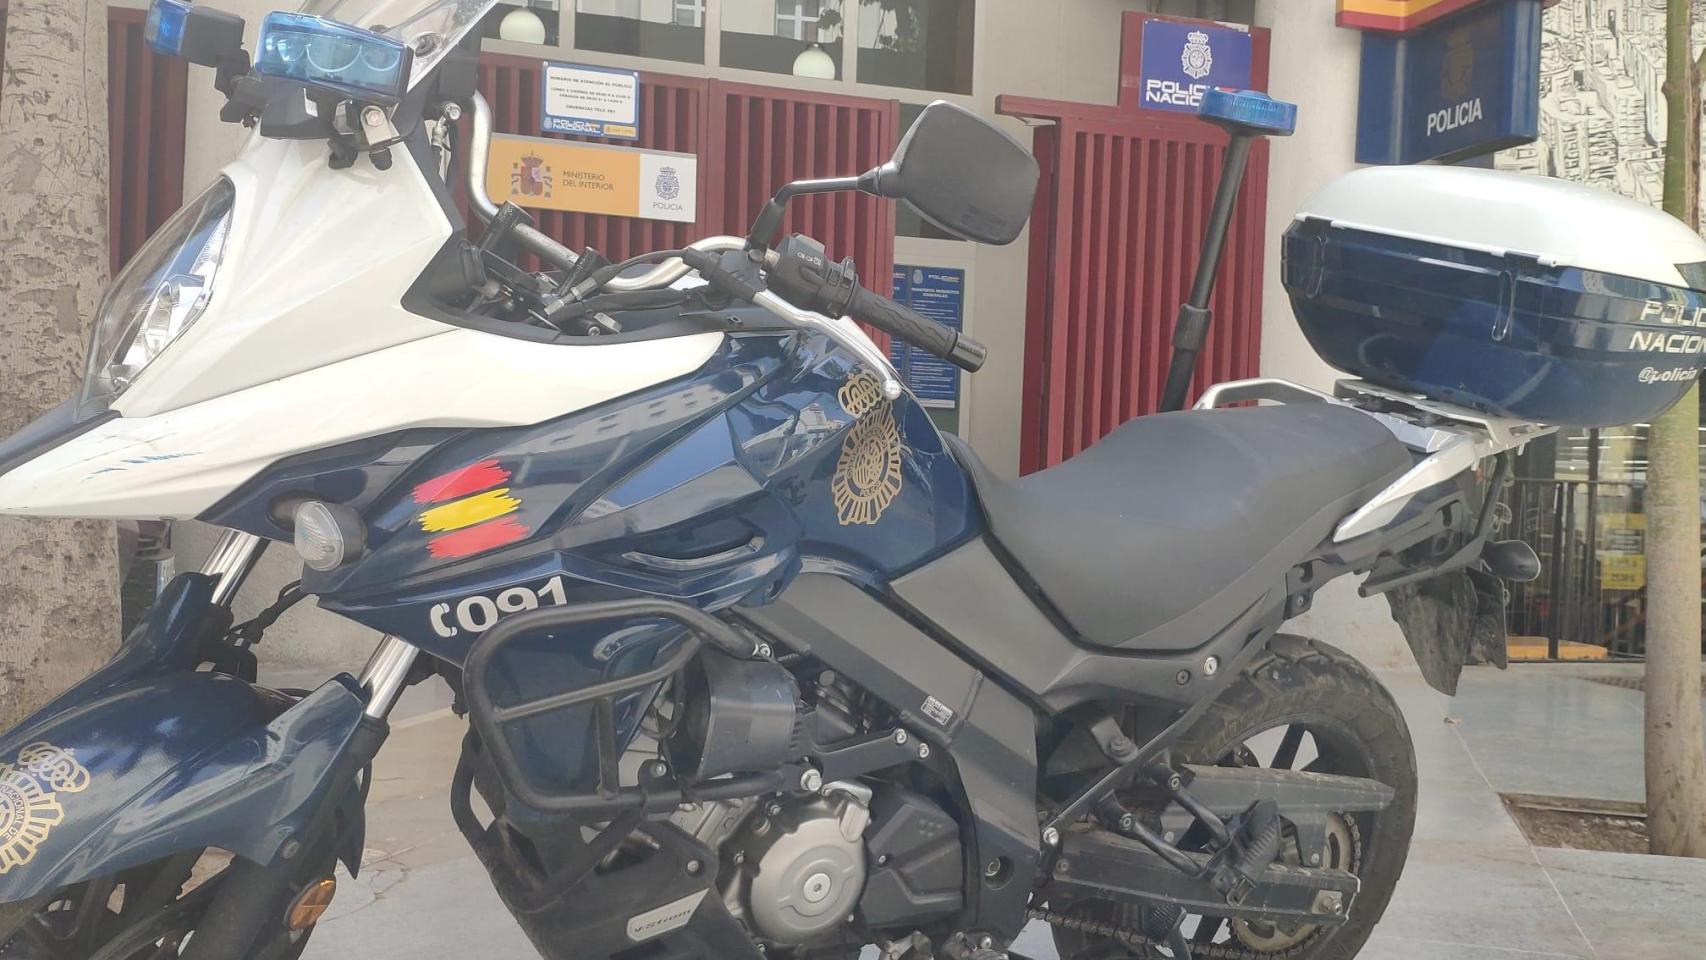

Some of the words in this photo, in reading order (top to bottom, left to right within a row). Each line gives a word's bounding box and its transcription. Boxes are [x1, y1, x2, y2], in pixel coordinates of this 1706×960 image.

[1147, 79, 1220, 96] POLIC
[1146, 91, 1201, 107] NACIO
[1427, 97, 1483, 137] POLICIA
[552, 122, 601, 134] NACIONAL
[562, 170, 606, 182] MINISTERIO
[562, 179, 577, 188] DEL
[578, 181, 614, 191] INTERIOR
[652, 201, 684, 211] POLICIA
